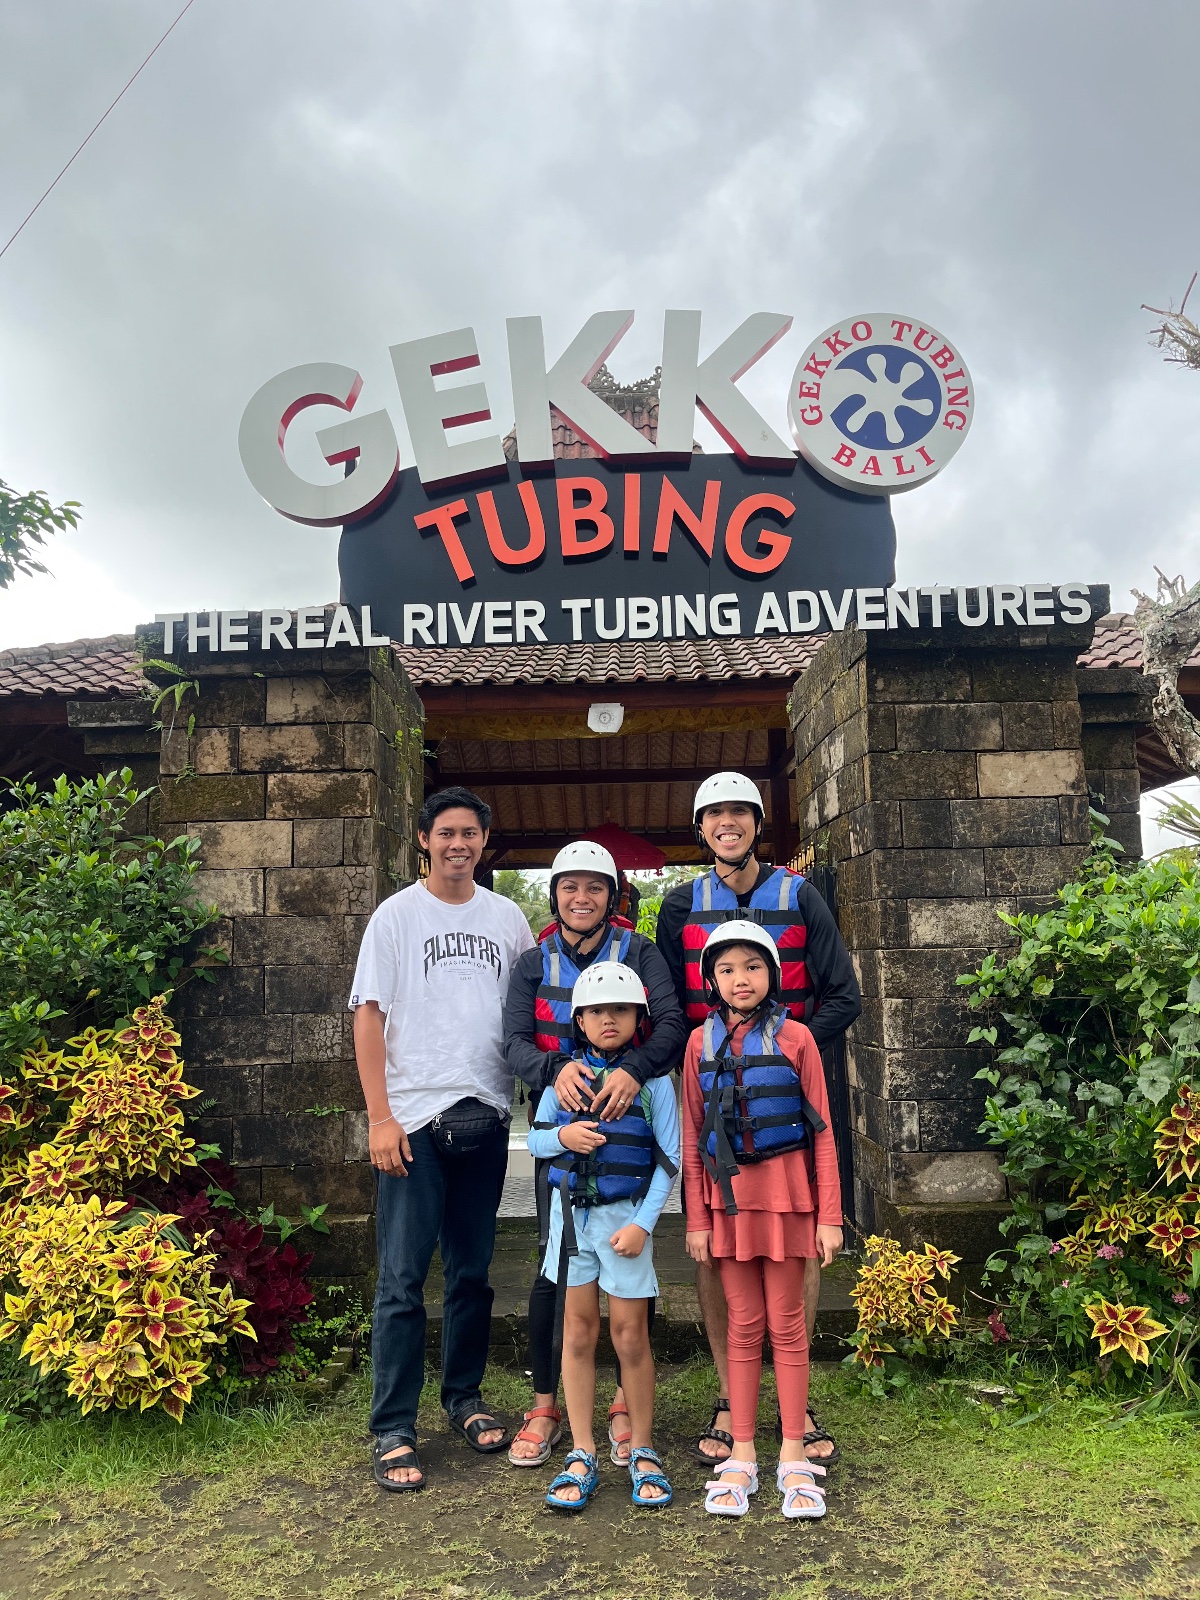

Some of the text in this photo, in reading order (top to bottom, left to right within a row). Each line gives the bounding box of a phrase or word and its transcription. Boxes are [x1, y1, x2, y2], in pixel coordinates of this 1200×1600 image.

[799, 320, 969, 431] GEKKO TUBING
[832, 443, 935, 476] BALI
[414, 472, 796, 583] TUBING
[155, 582, 1092, 655] THE REAL RIVER TUBING ADVENTURES
[440, 960, 487, 970] IMAGINAION
